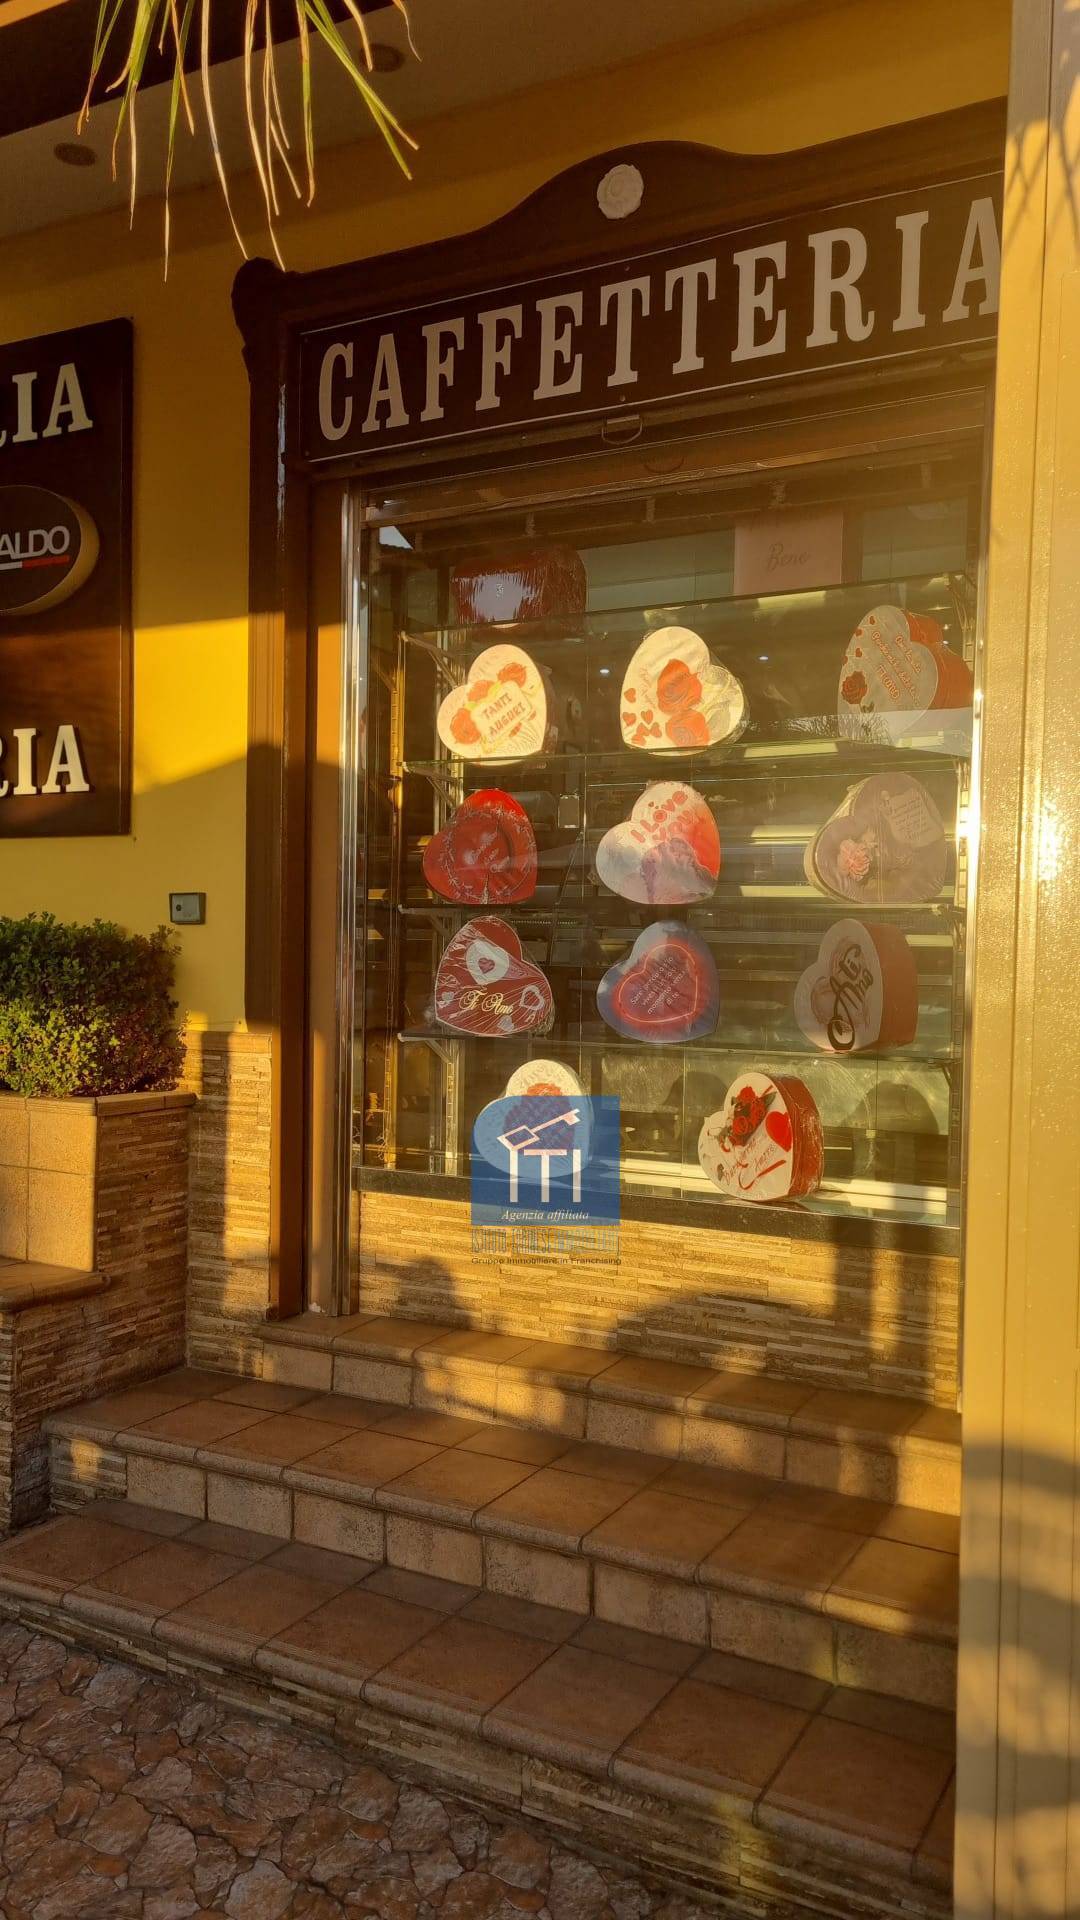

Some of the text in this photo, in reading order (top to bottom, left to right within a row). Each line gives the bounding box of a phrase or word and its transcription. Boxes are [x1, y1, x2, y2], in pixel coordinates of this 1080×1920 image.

[317, 195, 1002, 443] CAFFETTERIA
[0, 362, 94, 448] IA
[482, 693, 512, 720] TANTI
[489, 702, 526, 738] AUGURI
[0, 724, 90, 798] IA
[459, 989, 514, 1015] Ti Amo
